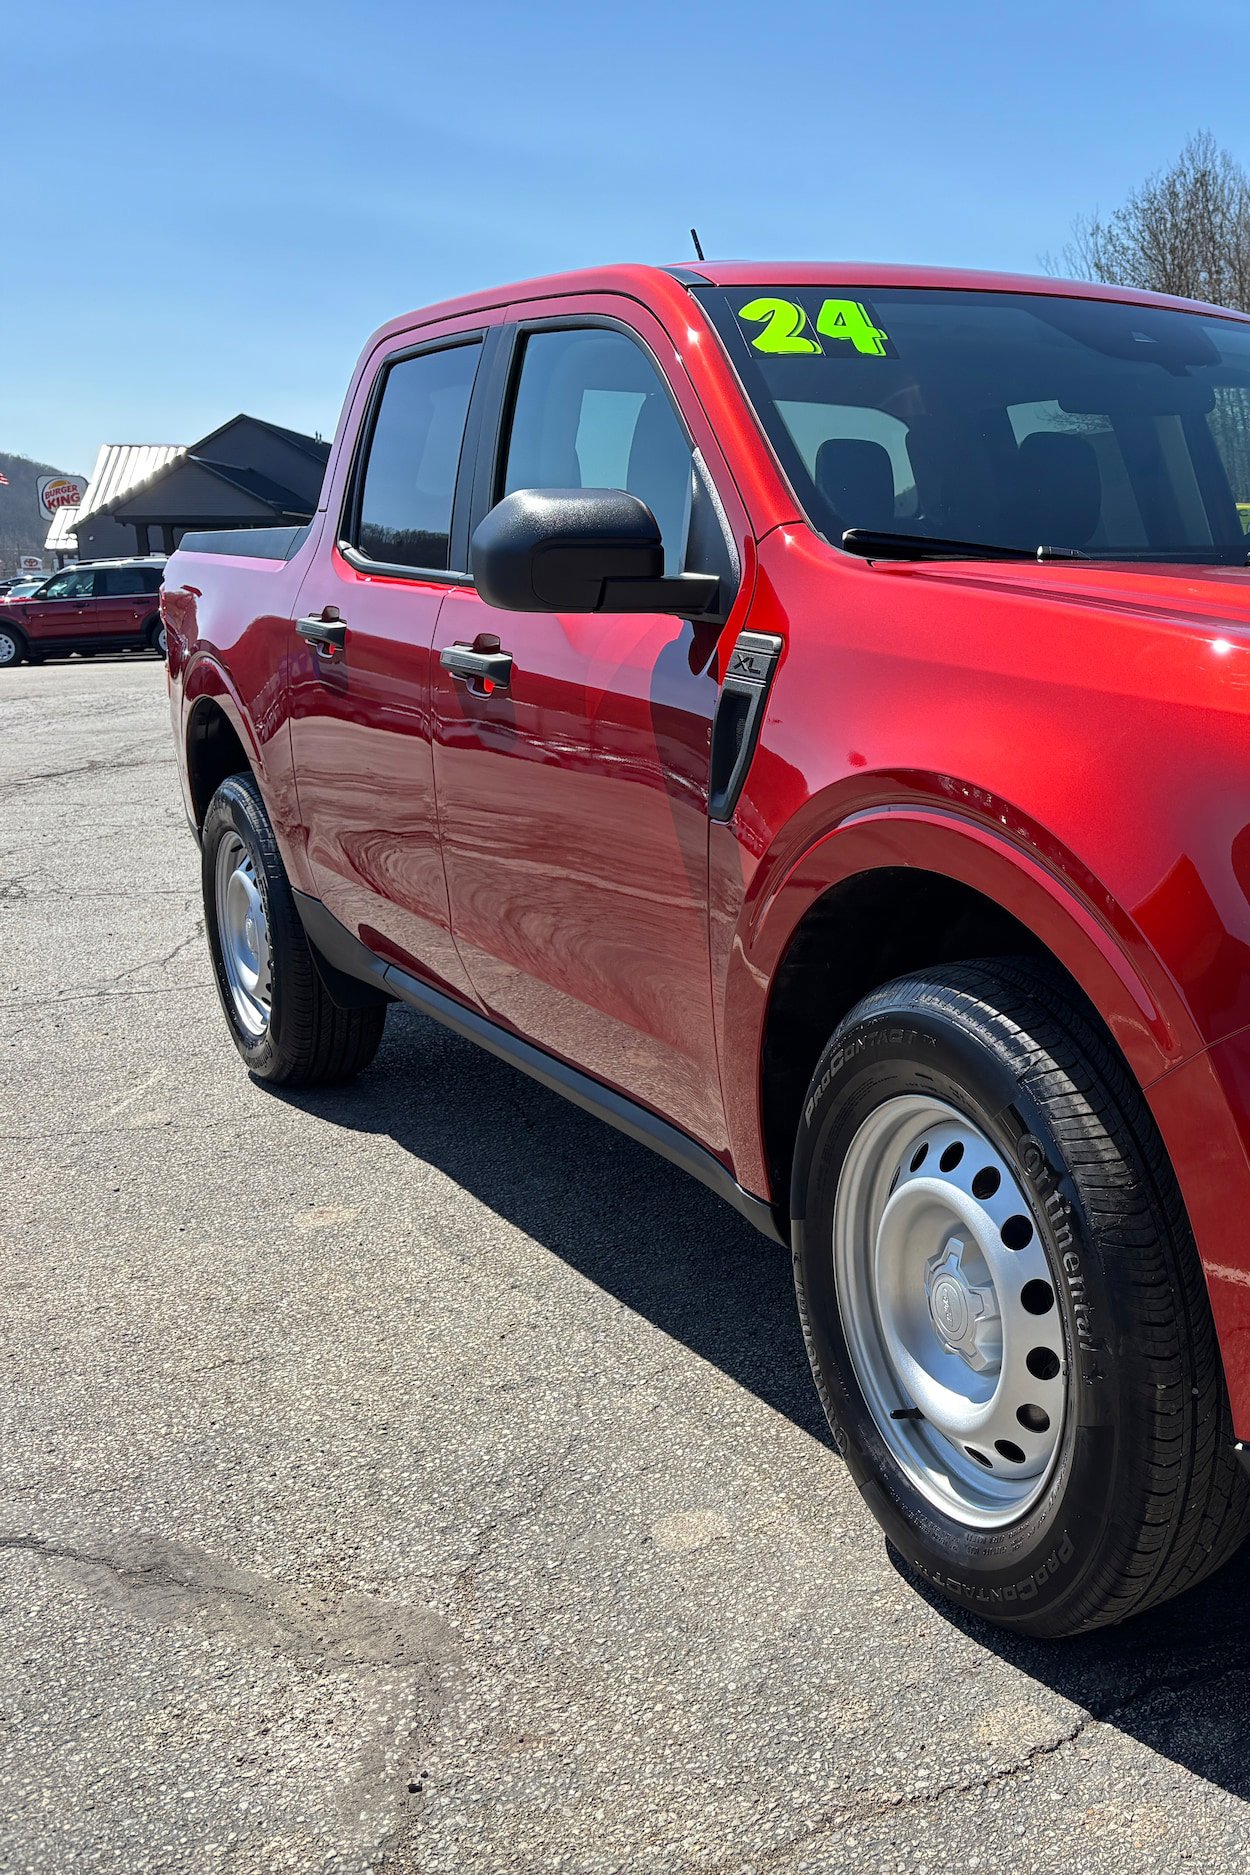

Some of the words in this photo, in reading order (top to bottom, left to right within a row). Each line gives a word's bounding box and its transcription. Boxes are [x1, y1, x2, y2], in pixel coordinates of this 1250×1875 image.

[738, 297, 888, 356] 24
[44, 484, 78, 500] BURGER
[46, 492, 81, 510] KING
[733, 654, 761, 675] XL
[1016, 1133, 1100, 1352] Continental
